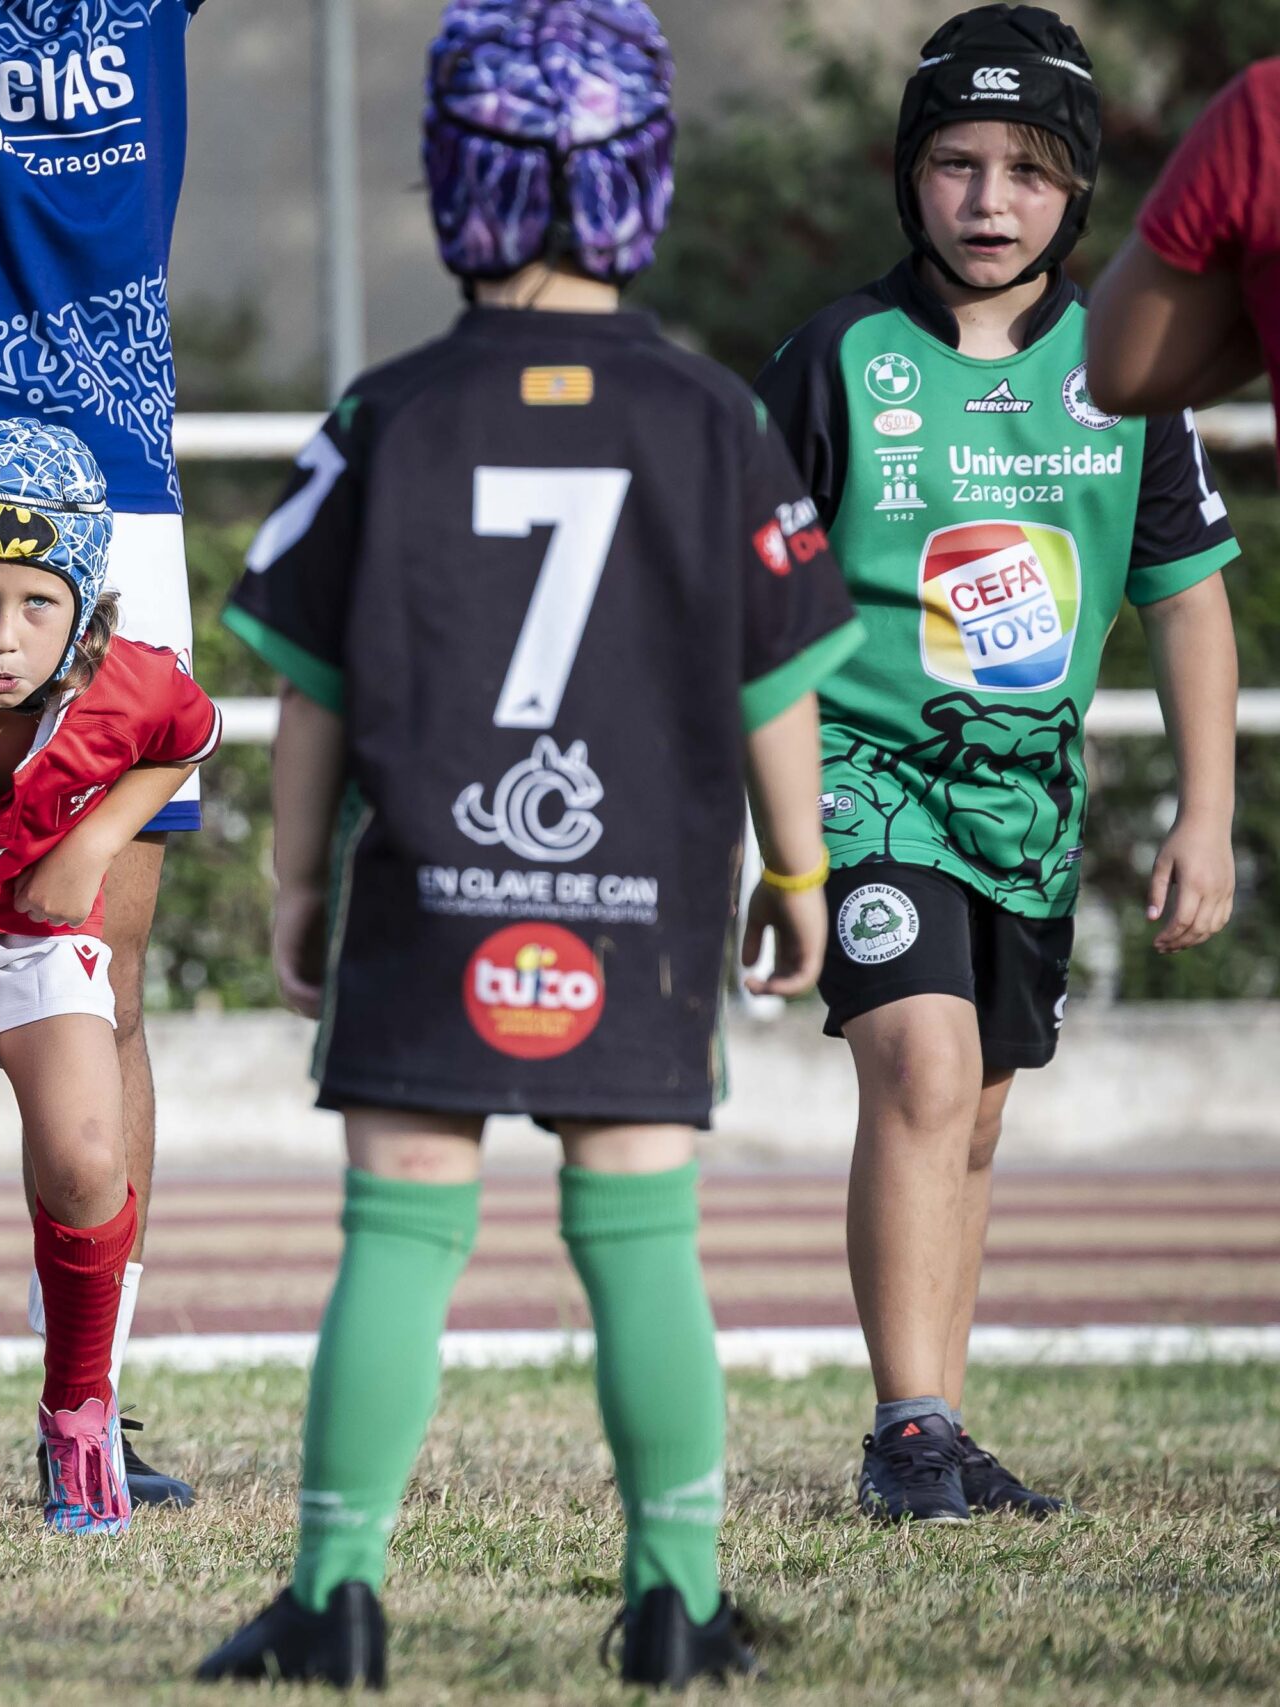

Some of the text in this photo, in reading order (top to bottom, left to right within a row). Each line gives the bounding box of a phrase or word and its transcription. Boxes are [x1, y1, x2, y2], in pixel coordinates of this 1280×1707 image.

[17, 142, 146, 176] Zaragoza
[871, 355, 911, 372] BMW
[966, 401, 1031, 412] MERCURY
[949, 445, 1123, 476] Universidad
[952, 479, 1064, 509] Zaragoza
[886, 512, 914, 521] 1542
[472, 465, 632, 729] 7
[951, 560, 1042, 612] CEFA
[966, 604, 1056, 656] TOYS
[556, 872, 597, 904] DE
[840, 886, 917, 955] CLUB DEPORTIVO UNIVERSITARIO
[861, 942, 908, 961] ZARAGOZA
[865, 930, 901, 951] RUGBY
